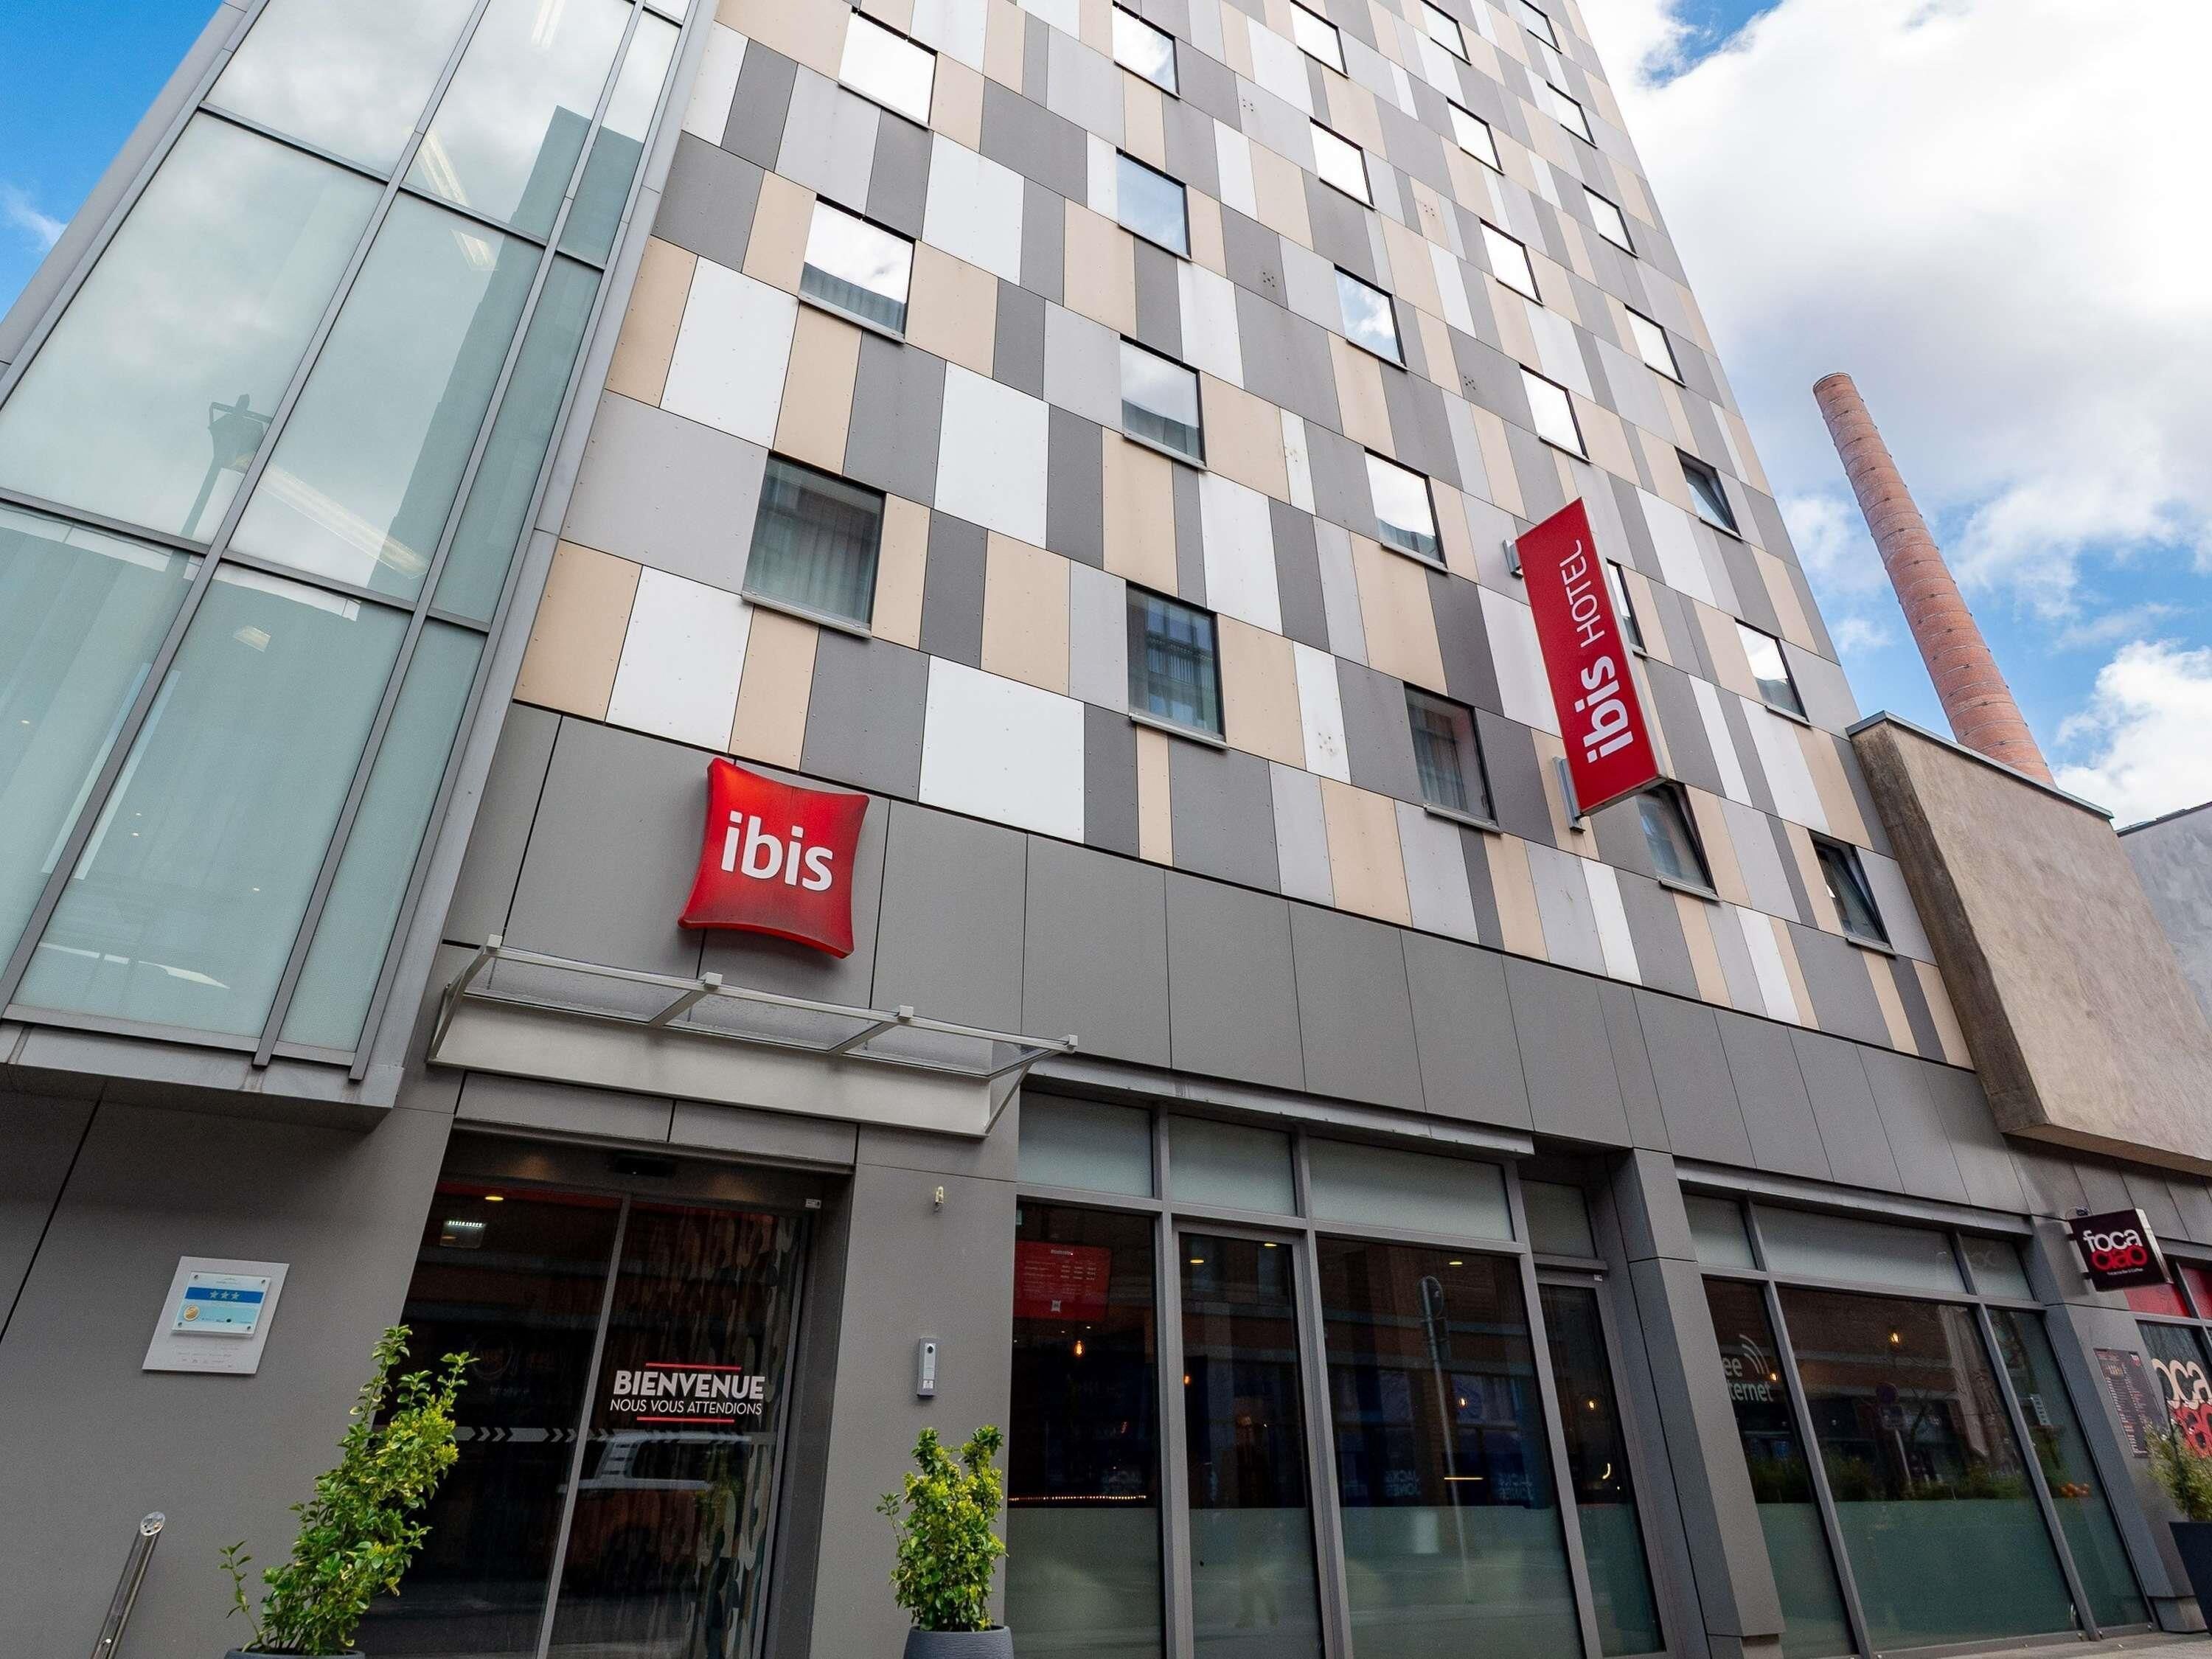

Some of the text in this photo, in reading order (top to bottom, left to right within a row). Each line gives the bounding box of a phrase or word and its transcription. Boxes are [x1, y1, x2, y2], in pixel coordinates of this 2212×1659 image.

[1559, 540, 1633, 763] ibis HOTEL
[720, 810, 833, 891] ibis
[2082, 1228, 2143, 1253] foca
[613, 1370, 765, 1399] BIENVENUE
[610, 1399, 762, 1415] NOUS VOUS ATTENDIONS
